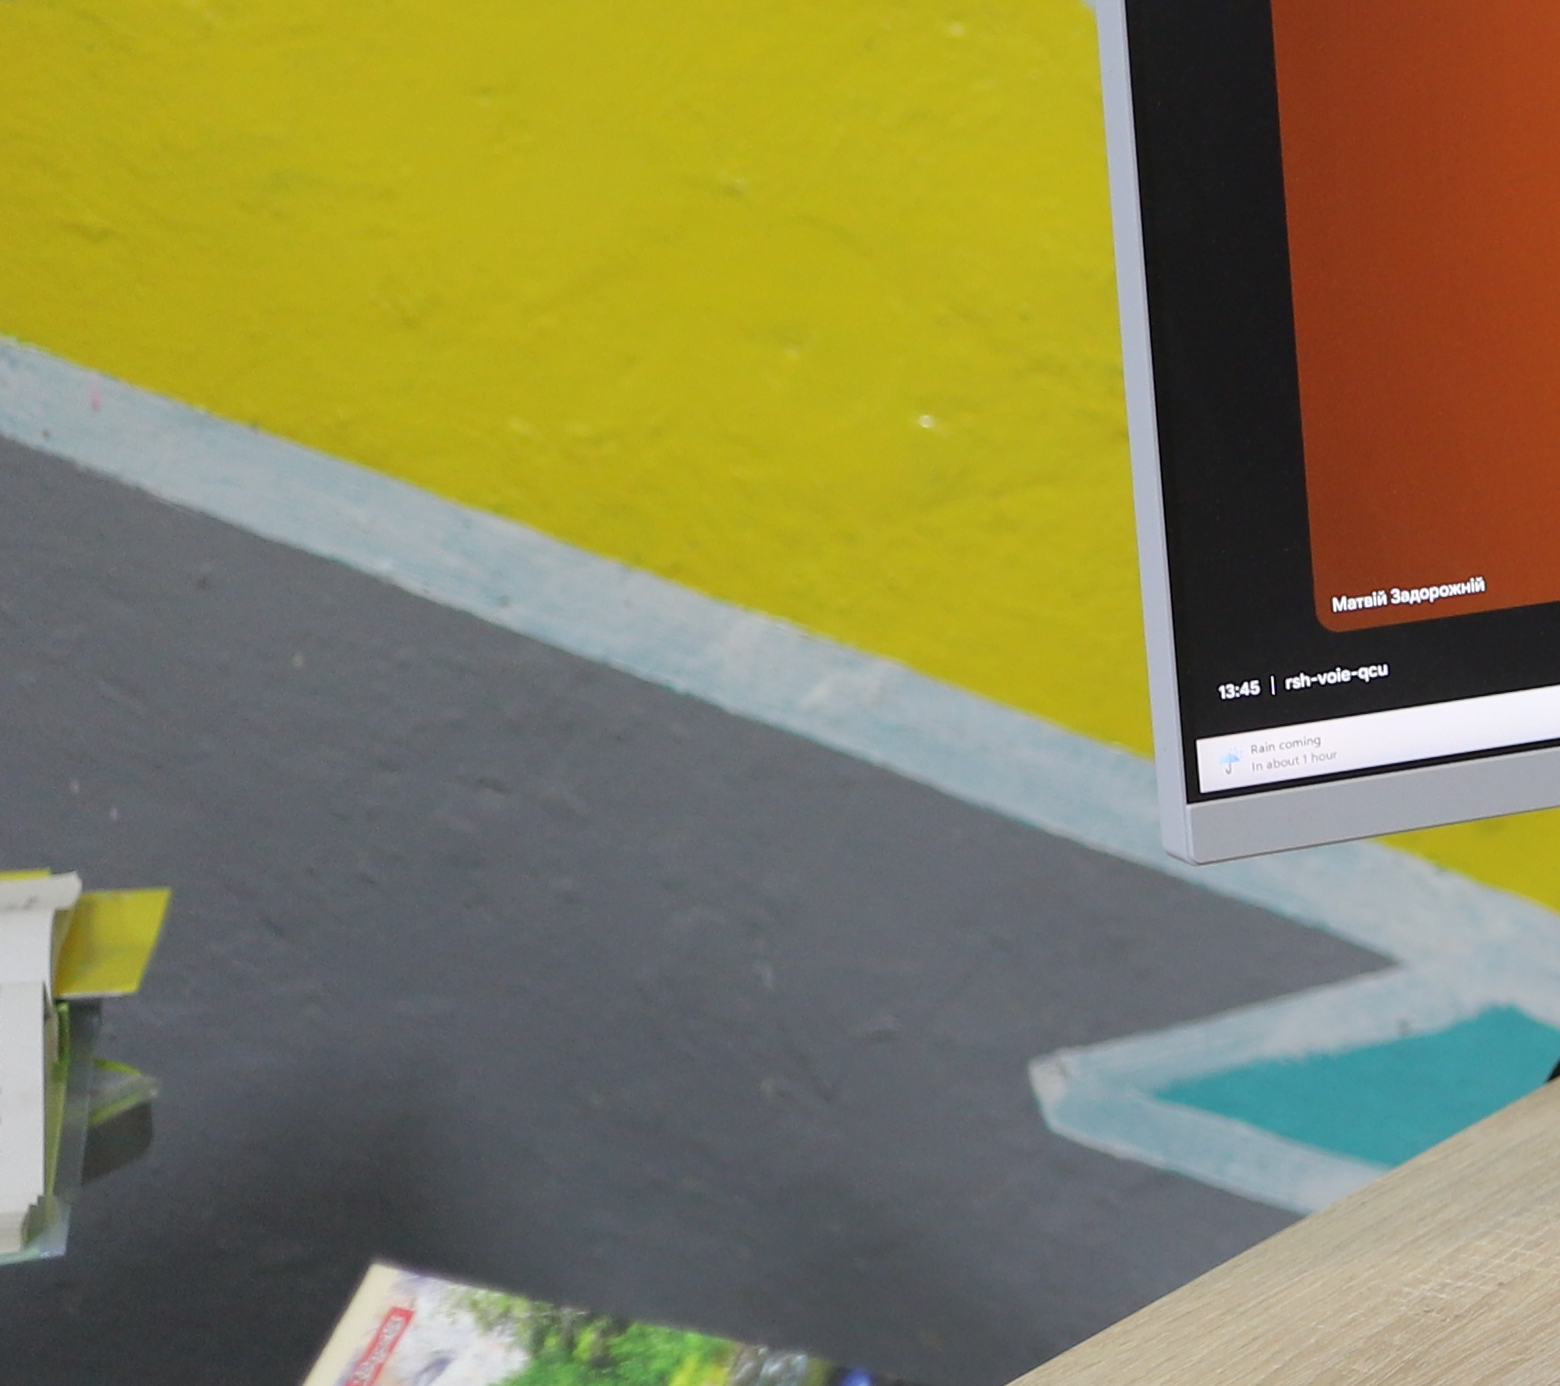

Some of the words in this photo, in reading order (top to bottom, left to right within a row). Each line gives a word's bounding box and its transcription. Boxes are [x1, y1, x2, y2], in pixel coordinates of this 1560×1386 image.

[1331, 589, 1387, 613] Матвій
[1390, 577, 1486, 605] Задорожній
[1218, 680, 1261, 700] 13:45
[1285, 663, 1389, 691] rsh-voie-qcu
[1251, 742, 1276, 755] Rain
[1279, 735, 1321, 751] coming
[1252, 762, 1263, 772] In
[1267, 755, 1300, 770] about
[1311, 750, 1337, 762] hour
